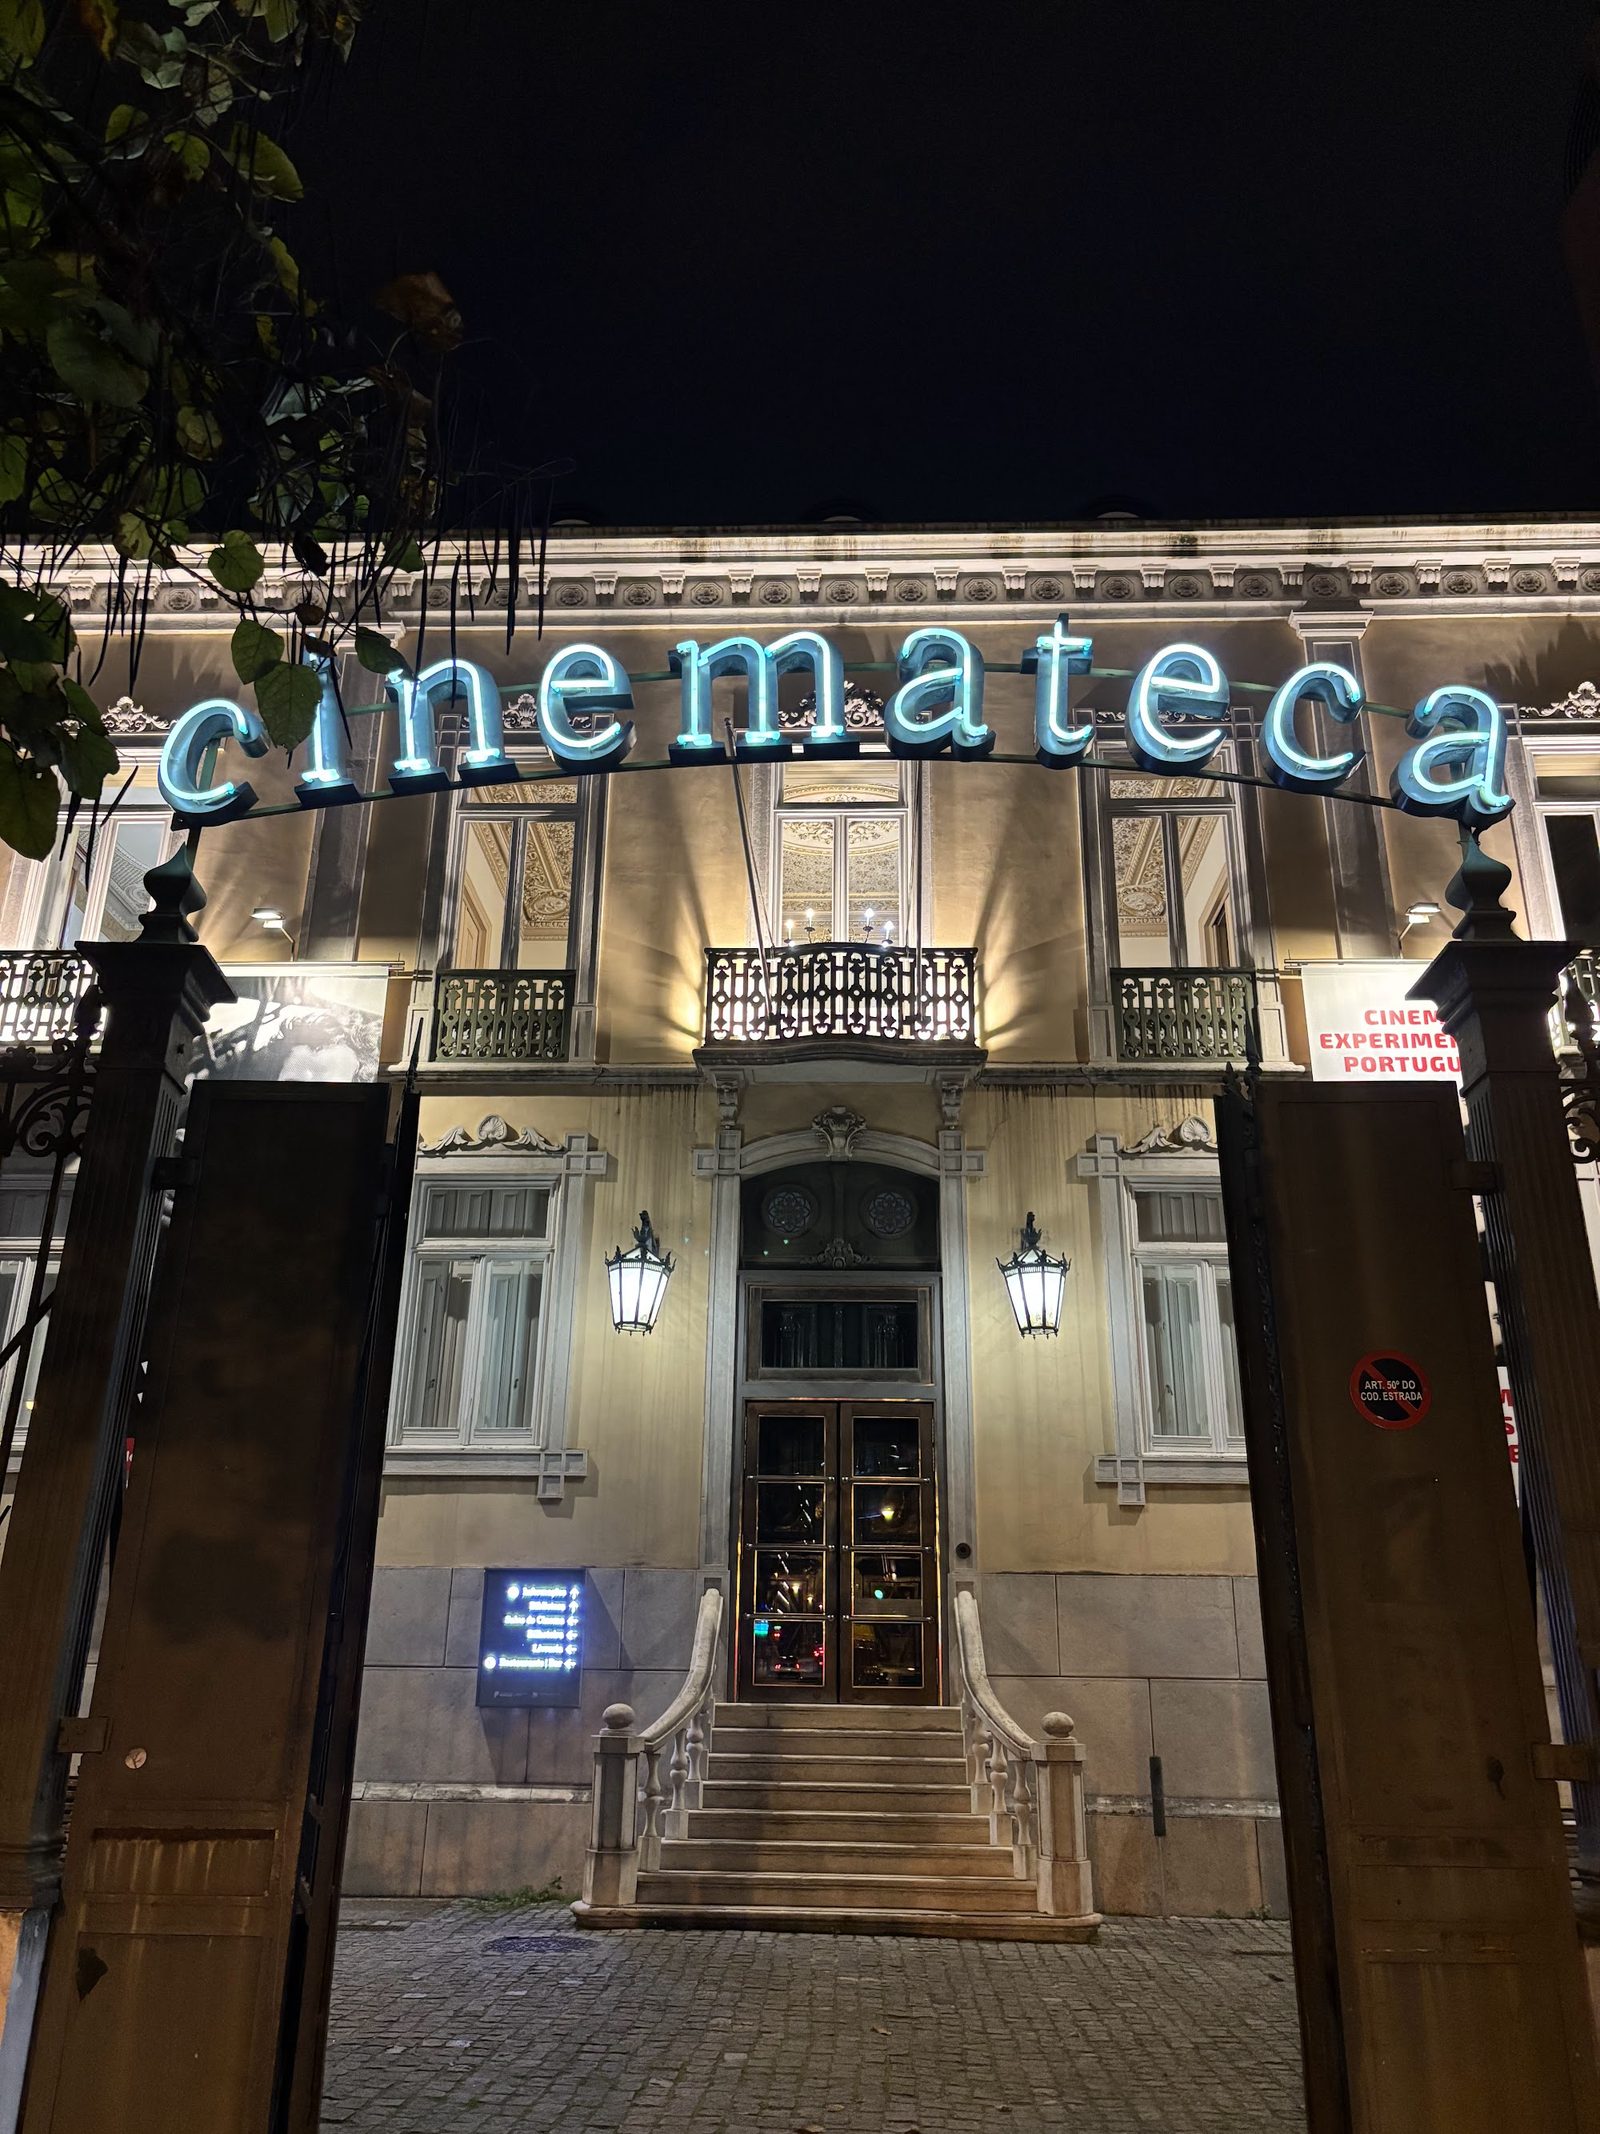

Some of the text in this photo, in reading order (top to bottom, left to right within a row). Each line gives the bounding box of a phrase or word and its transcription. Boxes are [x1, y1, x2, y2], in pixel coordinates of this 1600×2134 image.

[158, 612, 1514, 824] cinemateca
[1364, 1380, 1385, 1390] ART.
[1401, 1380, 1416, 1390] DO
[1360, 1391, 1423, 1401] COD. ESTRADA
